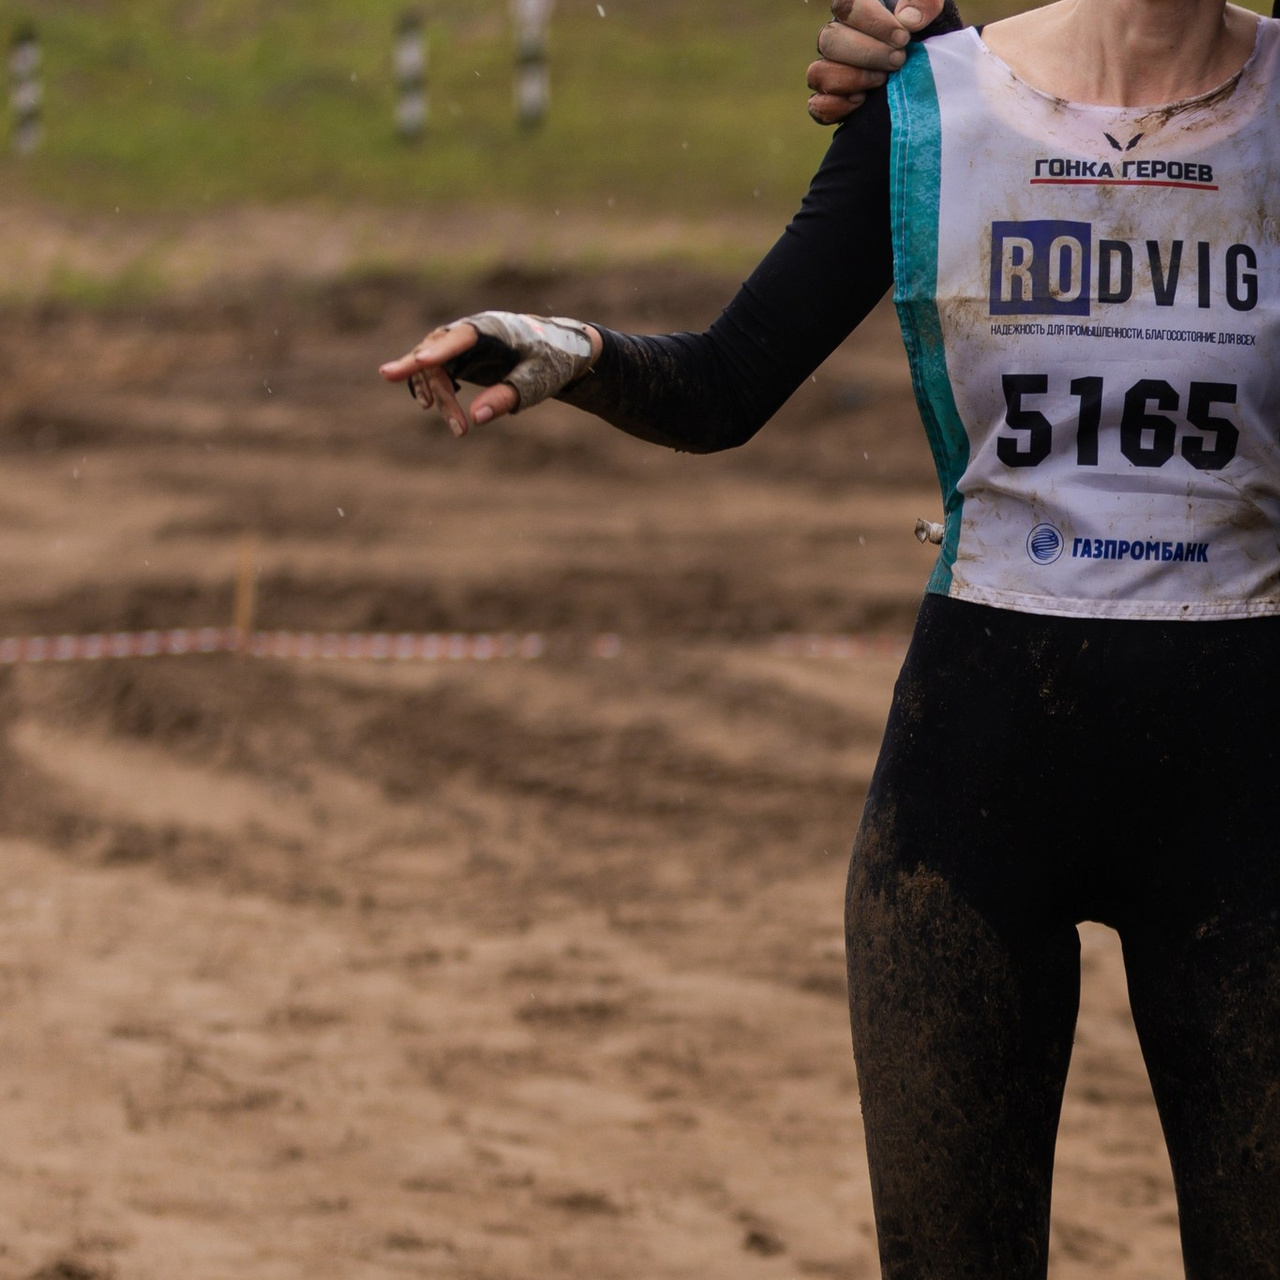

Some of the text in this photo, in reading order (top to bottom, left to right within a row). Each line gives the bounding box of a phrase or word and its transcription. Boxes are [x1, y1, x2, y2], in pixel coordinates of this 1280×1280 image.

[1034, 159, 1213, 183] ГОНКА ГЕРОЕВ
[1000, 236, 1258, 312] RODVIG
[990, 324, 1045, 336] НАДЕЖНОСТЬ
[1046, 324, 1065, 336] ДЛЯ
[1145, 328, 1216, 344] БЛАГОСОСТОЯНИЕ
[1217, 333, 1236, 344] ДЛЯ
[1236, 334, 1256, 346] ВСЕХ
[997, 374, 1239, 470] 5165
[1072, 538, 1208, 562] ГАЗПРОМБАНК
